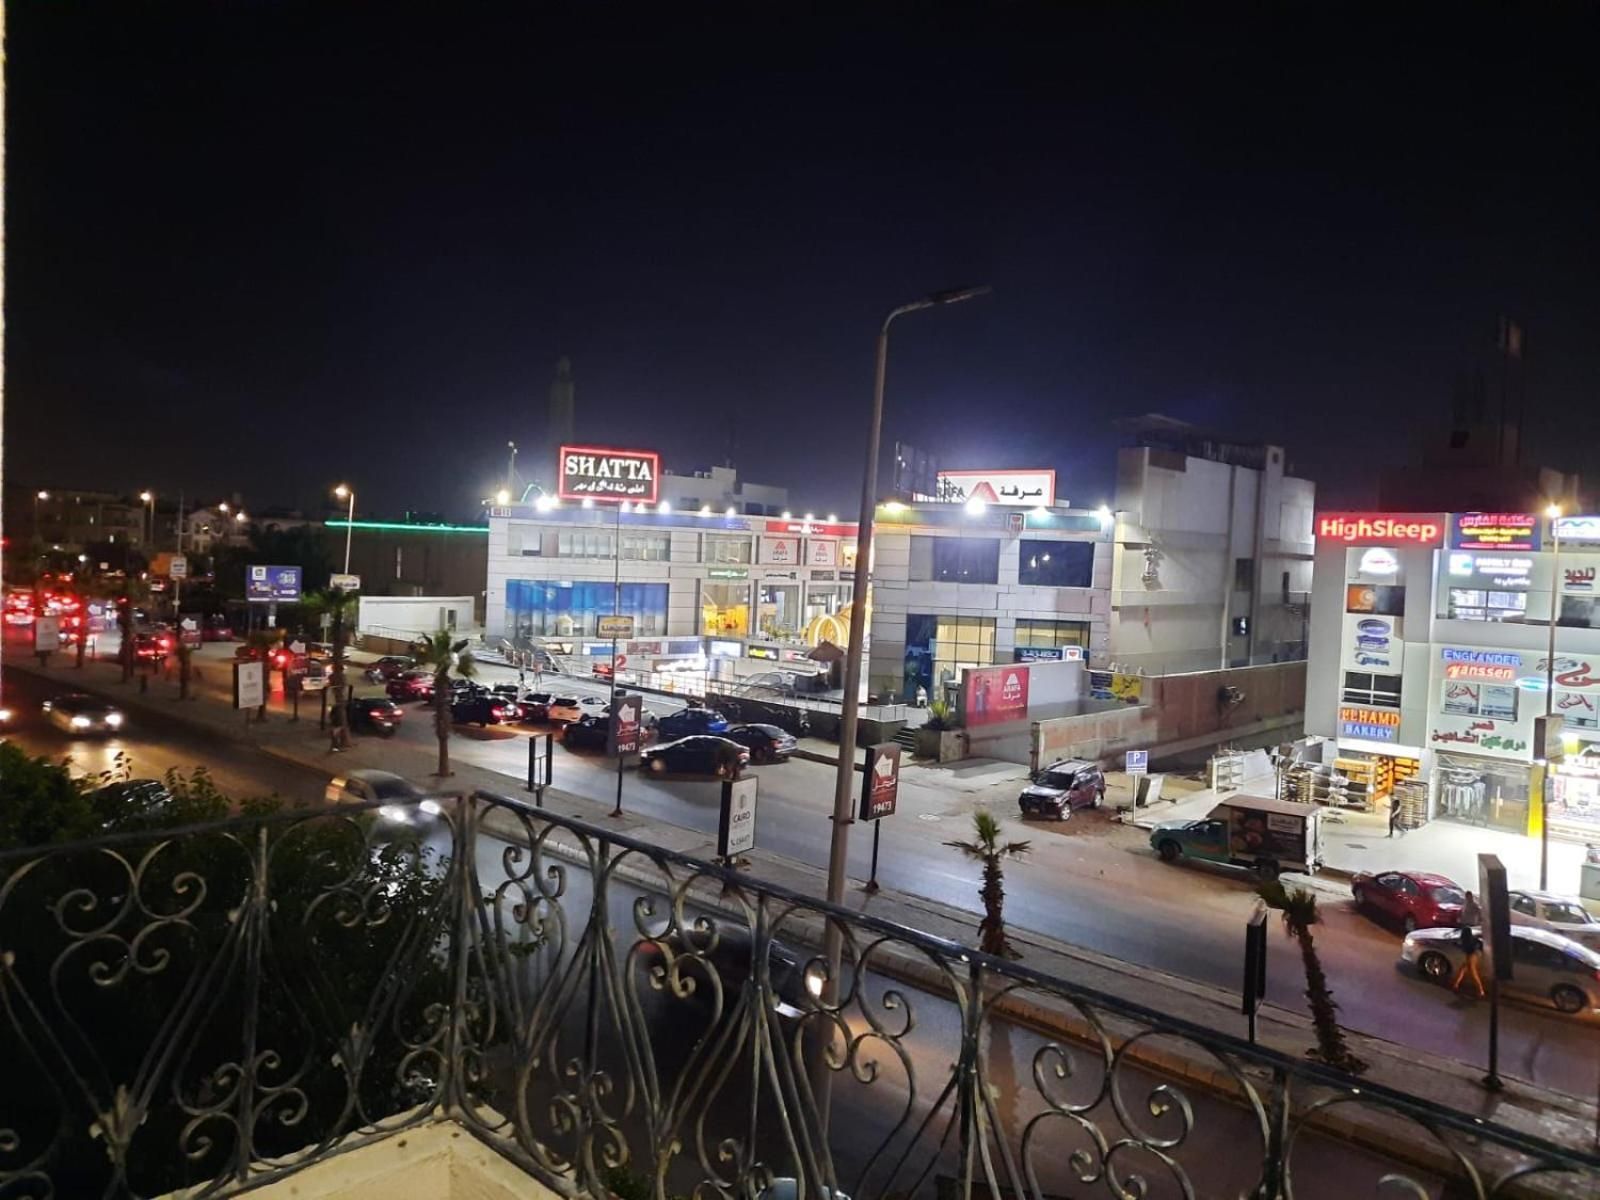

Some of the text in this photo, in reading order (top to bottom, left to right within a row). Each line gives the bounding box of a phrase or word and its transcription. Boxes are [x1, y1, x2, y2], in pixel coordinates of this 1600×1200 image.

[565, 455, 652, 481] SHATTA
[999, 485, 1043, 500] عرفة
[1320, 517, 1437, 542] HighSleep
[615, 653, 628, 671] 2
[1443, 649, 1521, 665] ENGLANDER
[1344, 723, 1393, 739] BAKERY
[1469, 720, 1496, 731] قصر
[1133, 753, 1140, 764] P
[872, 801, 892, 814] 19473
[733, 811, 751, 823] CAIRO
